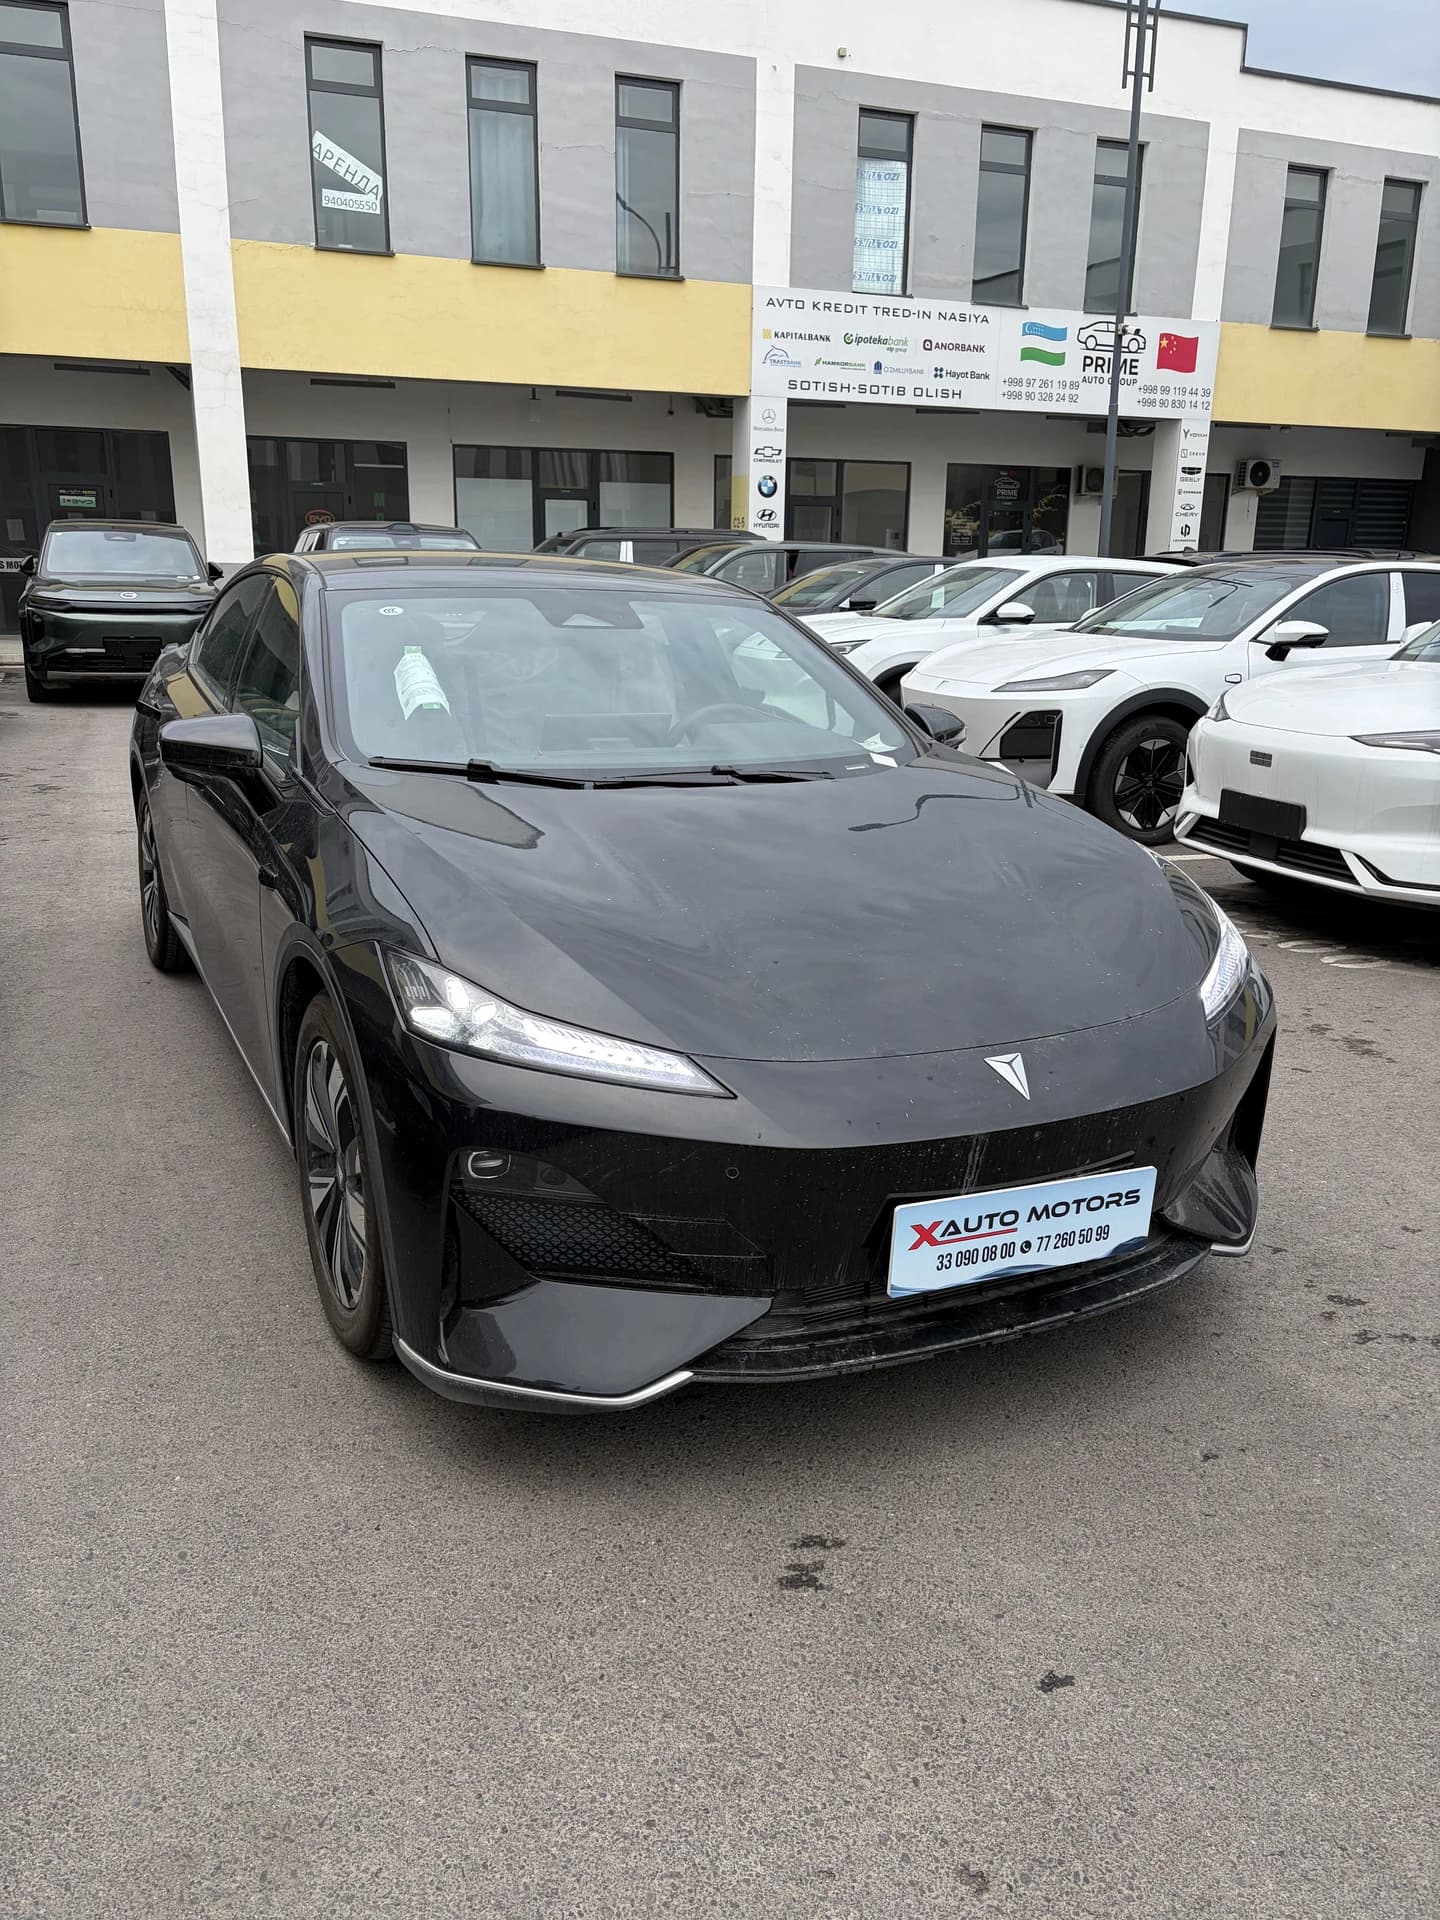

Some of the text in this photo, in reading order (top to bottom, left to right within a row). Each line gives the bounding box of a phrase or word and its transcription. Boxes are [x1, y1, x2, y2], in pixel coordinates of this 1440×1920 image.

[312, 143, 379, 200] АРЕНДА
[324, 195, 377, 211] 940405550
[766, 298, 990, 324] AVTO KREDIT TRED-IN NASIYA
[774, 331, 831, 342] KAPITALBANK
[854, 334, 909, 346] ipotekabank
[934, 342, 986, 353] ANORBANK
[945, 370, 990, 380] Hayot Bank
[1081, 376, 1138, 386] AUTO GOUP
[787, 380, 962, 400] SOTISH-SOTIB OLISH
[1002, 377, 1080, 390] +998 97 261 19 89
[1001, 390, 1079, 403] +998 90 328 24 92
[1138, 384, 1211, 397] +998 99 119 44 39
[1137, 398, 1210, 410] +998 90 830 14 12
[997, 488, 1018, 497] PRIME
[908, 1188, 1141, 1250] XAUTO MOTORS
[936, 1224, 1110, 1271] 33 090 08 00 77 260 50 99
